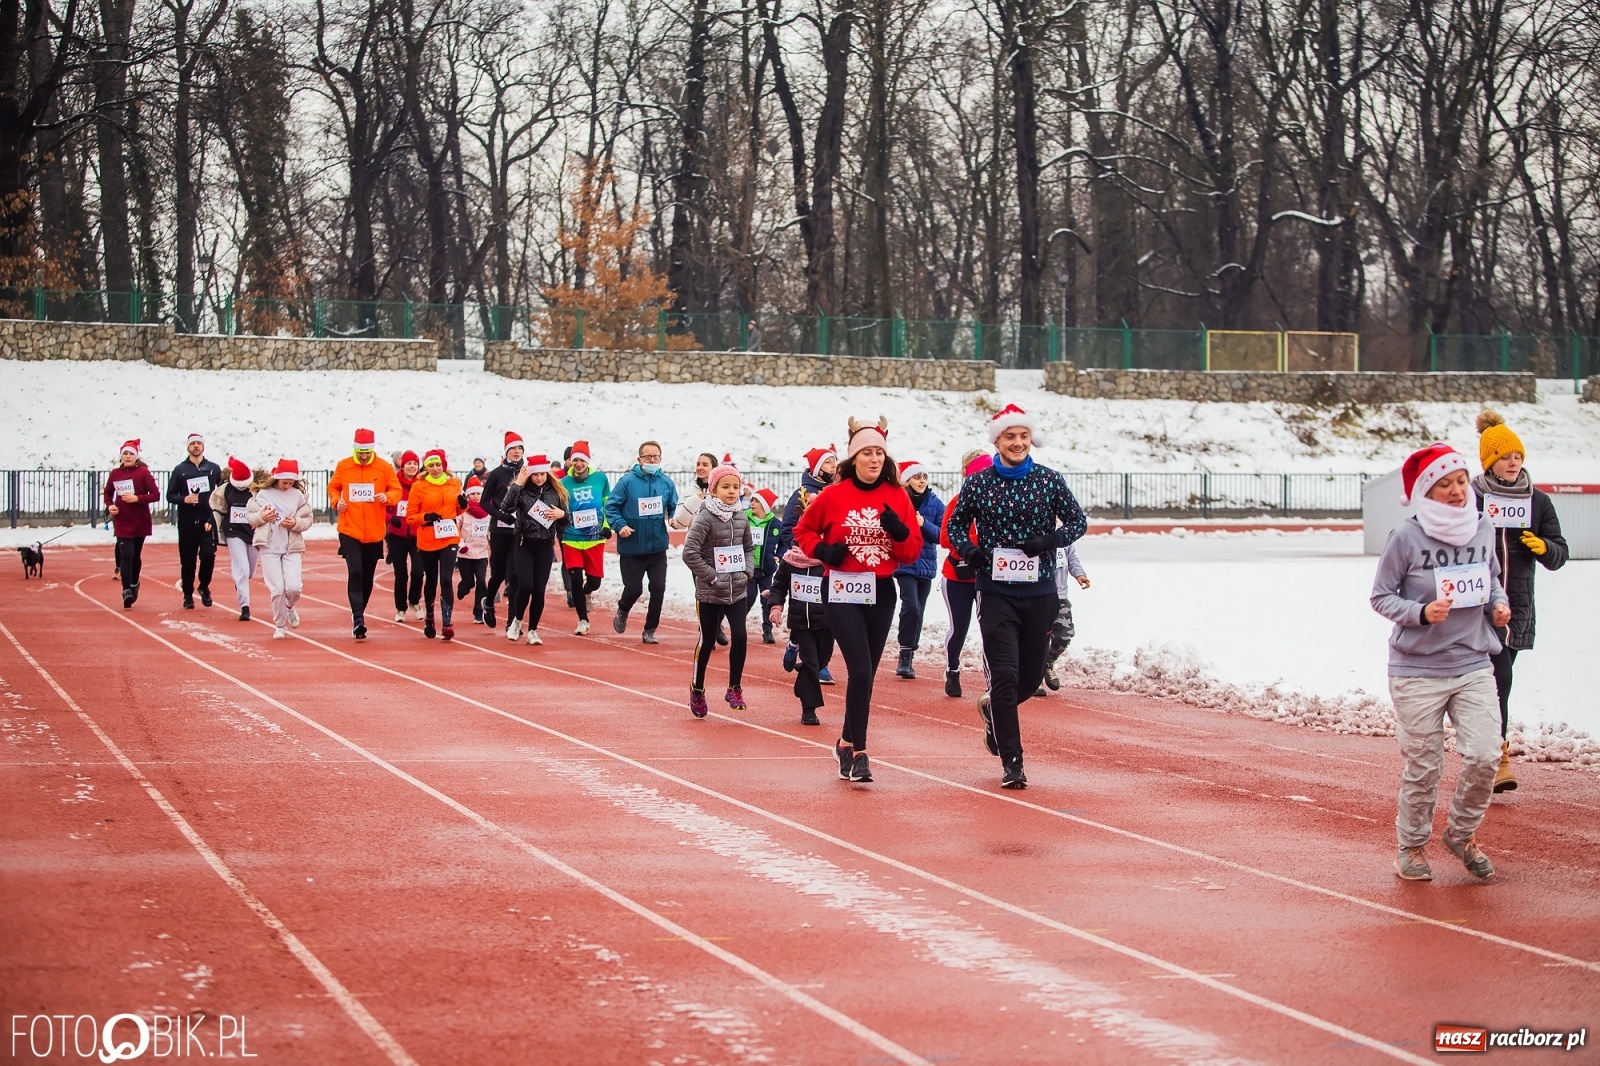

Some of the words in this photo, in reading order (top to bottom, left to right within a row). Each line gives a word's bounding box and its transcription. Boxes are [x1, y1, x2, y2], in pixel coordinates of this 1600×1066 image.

[357, 489, 373, 497] 052
[647, 501, 661, 510] 097
[1500, 506, 1526, 518] 100
[581, 514, 596, 523] 083
[850, 526, 888, 538] HAPPY
[844, 535, 893, 548] HOLIDAYS
[727, 553, 743, 564] 186
[1009, 560, 1035, 571] 026
[800, 584, 820, 595] 185
[845, 582, 872, 594] 028
[1456, 577, 1484, 594] 014
